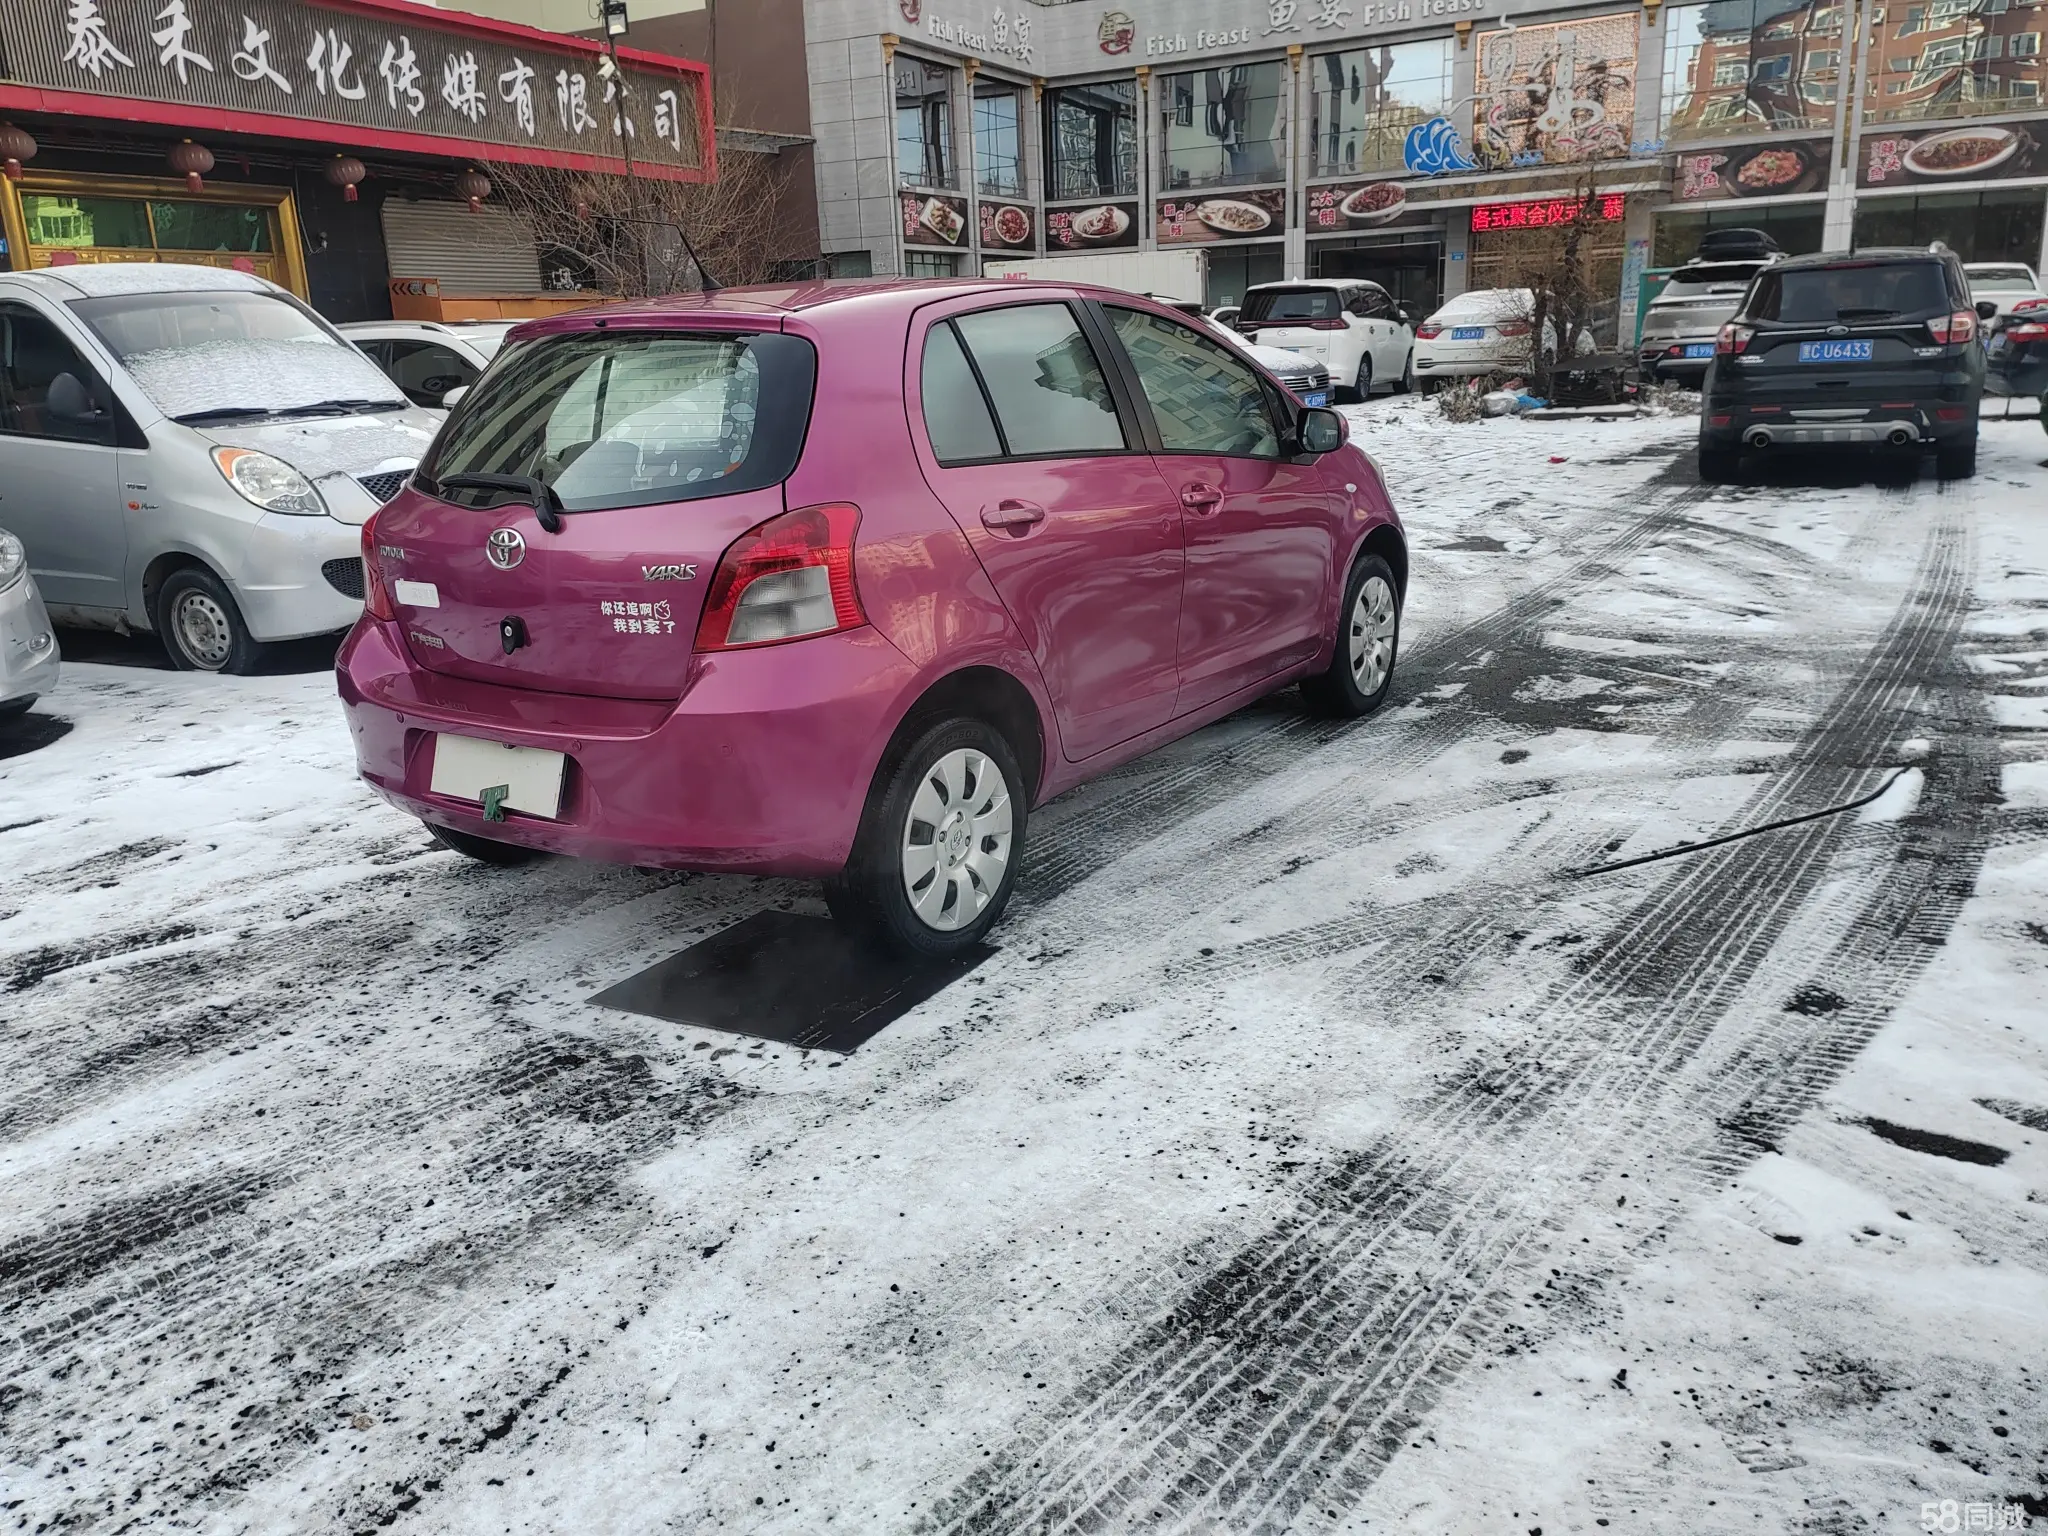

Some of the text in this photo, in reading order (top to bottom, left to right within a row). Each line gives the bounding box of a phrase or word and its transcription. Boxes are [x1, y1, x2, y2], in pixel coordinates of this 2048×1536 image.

[928, 14, 953, 43] Fish
[957, 24, 987, 51] feast
[1146, 35, 1188, 57] Fish
[1196, 25, 1250, 50] feast
[1363, 3, 1412, 26] Fish
[1421, 0, 1485, 18] feast
[601, 600, 653, 617] 你还追啊
[613, 617, 676, 634] 我到家了
